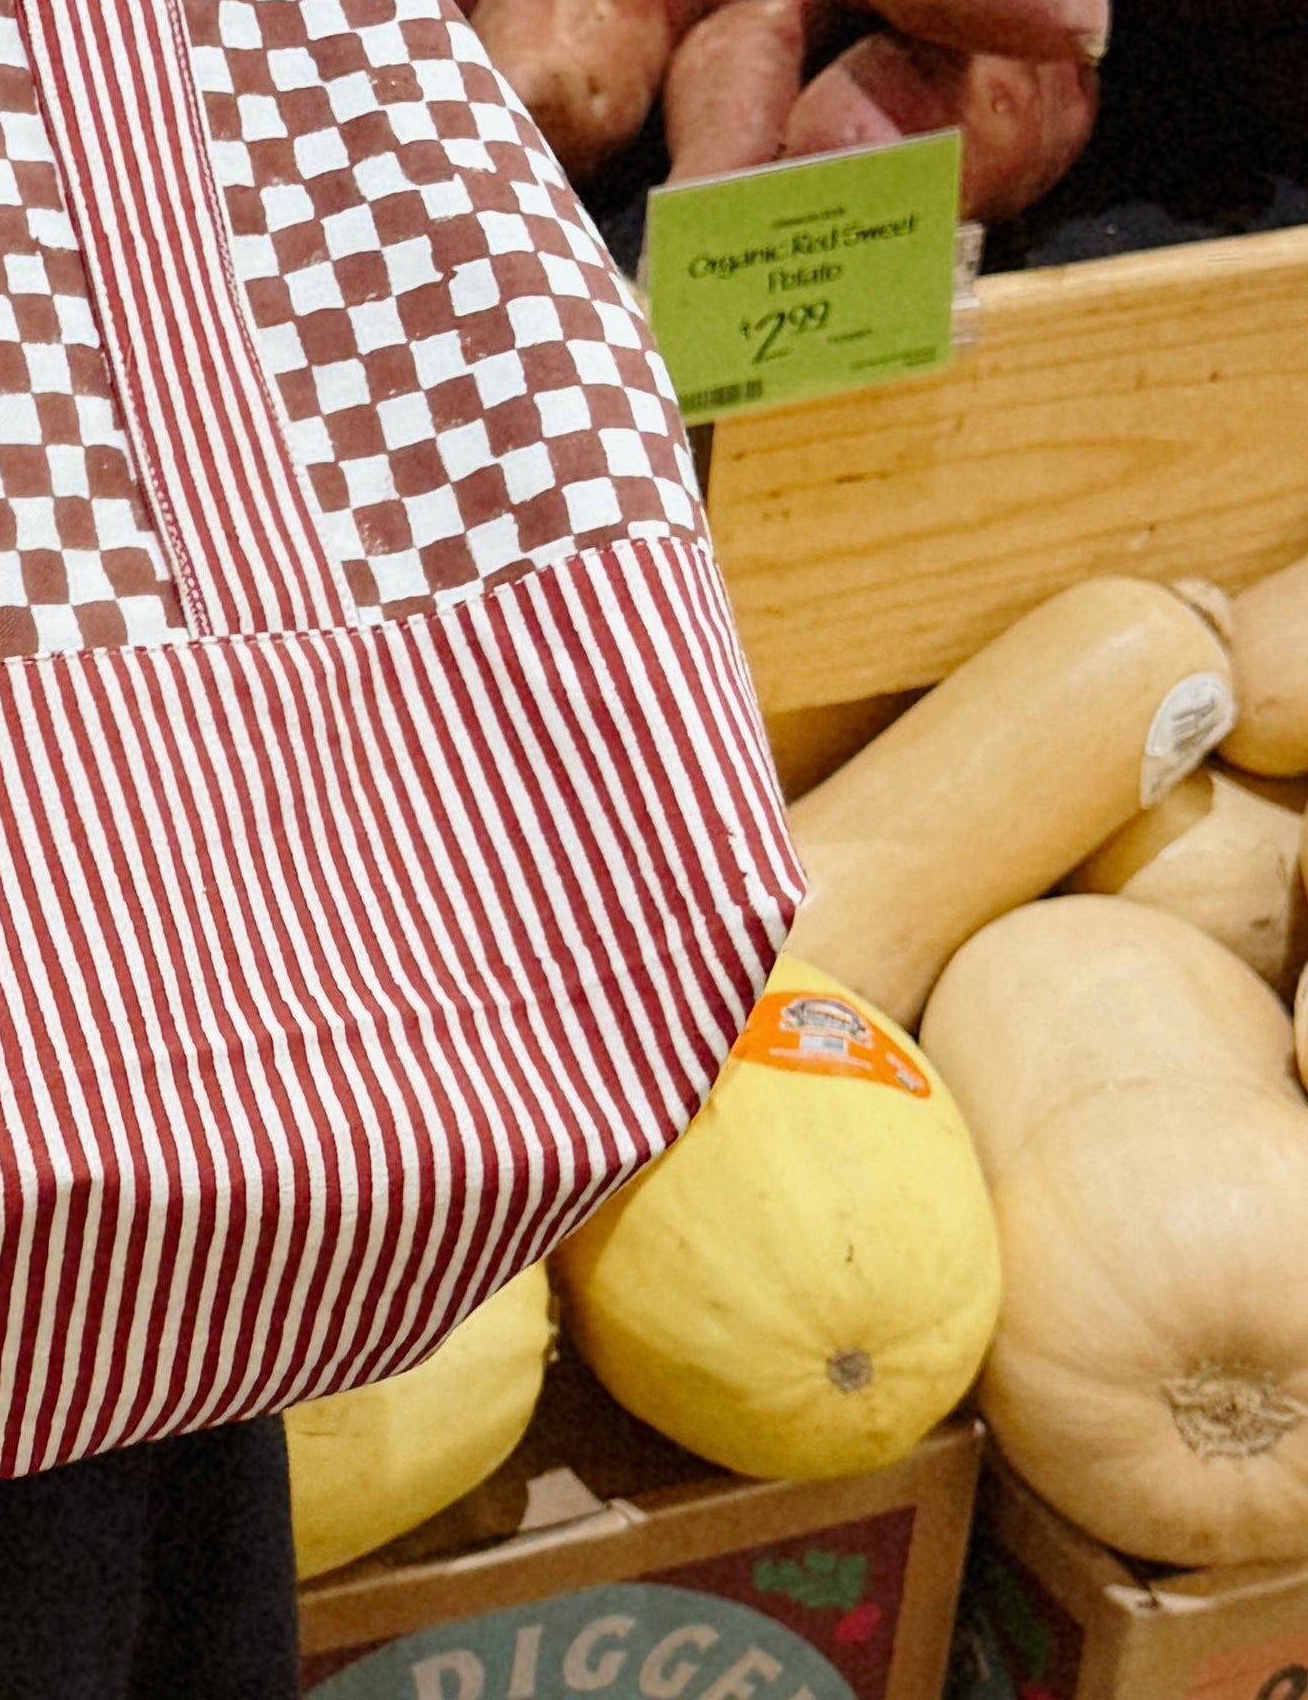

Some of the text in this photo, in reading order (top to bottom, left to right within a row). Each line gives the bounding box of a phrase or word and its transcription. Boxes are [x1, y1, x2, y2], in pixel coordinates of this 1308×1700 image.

[688, 245, 784, 280] Organic
[791, 228, 840, 253] Red
[843, 214, 918, 246] Sweet
[768, 264, 843, 294] Potato
[412, 1615, 812, 1700] DIGGE
